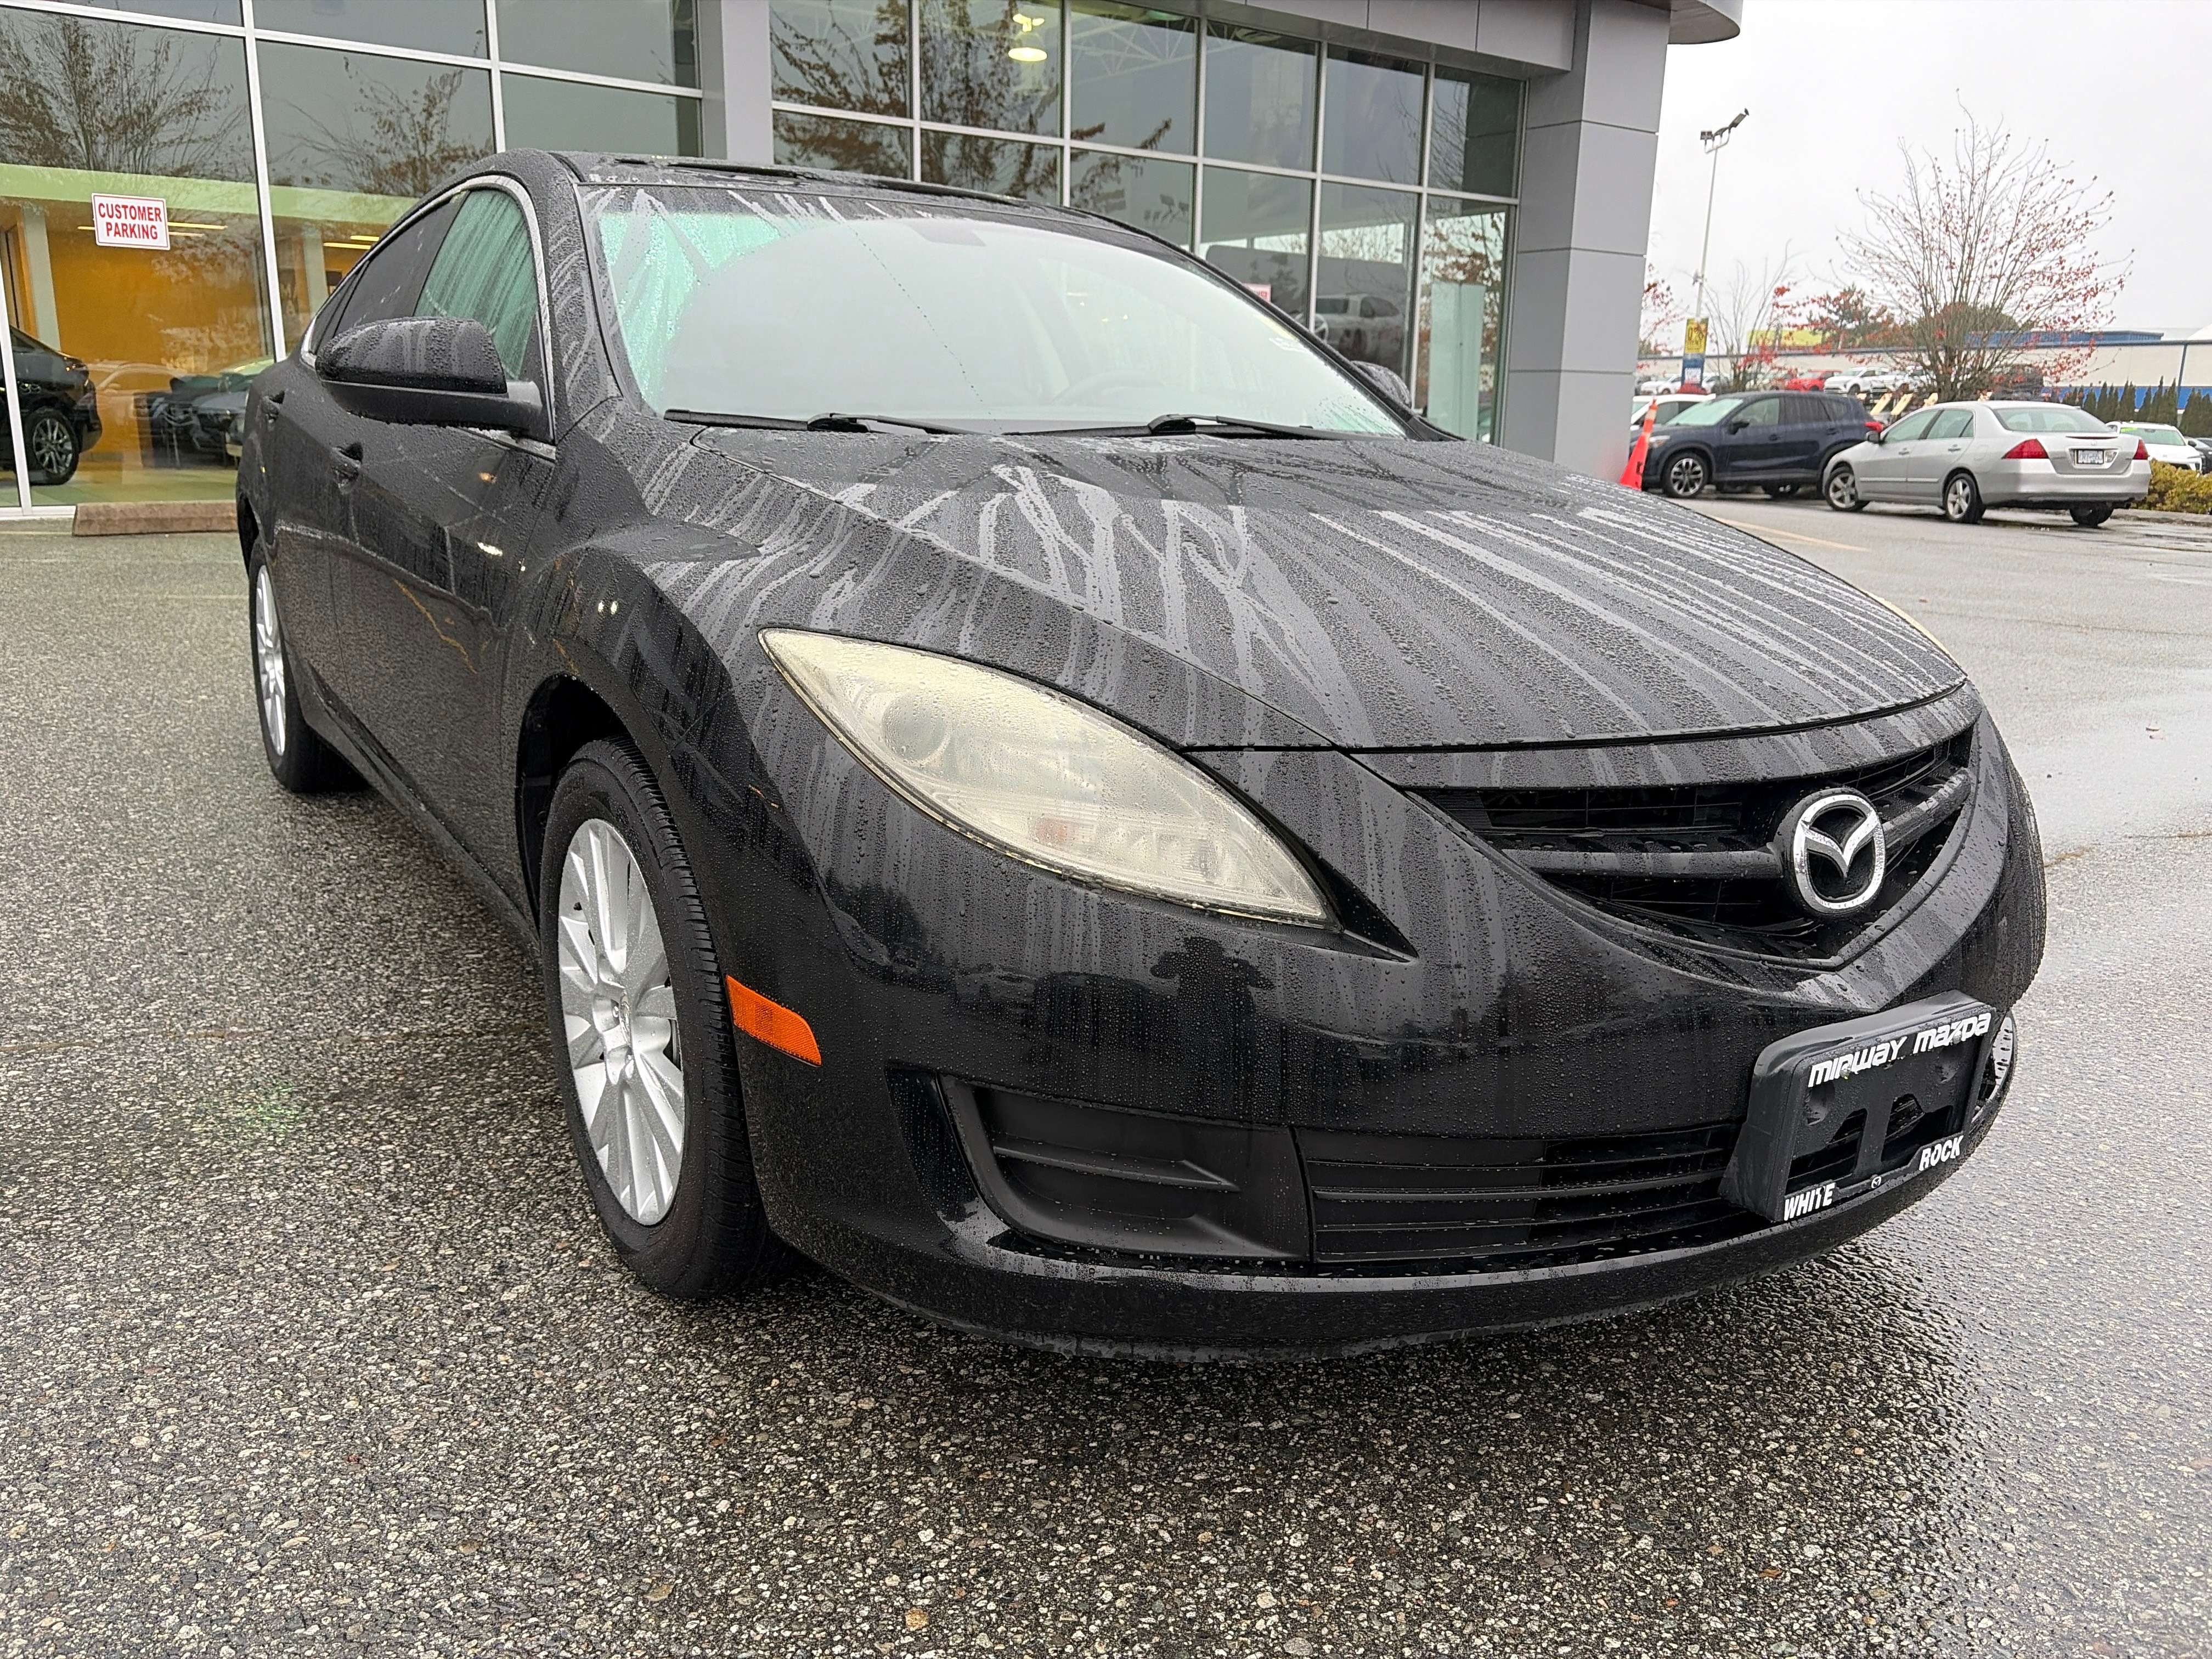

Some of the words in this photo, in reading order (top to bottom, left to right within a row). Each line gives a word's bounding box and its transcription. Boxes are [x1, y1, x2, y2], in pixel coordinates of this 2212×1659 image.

[99, 203, 162, 222] CUSTOMER
[105, 222, 158, 239] PARKING
[1784, 1182, 1836, 1221] WHITE
[1918, 1135, 1964, 1171] ROCK
